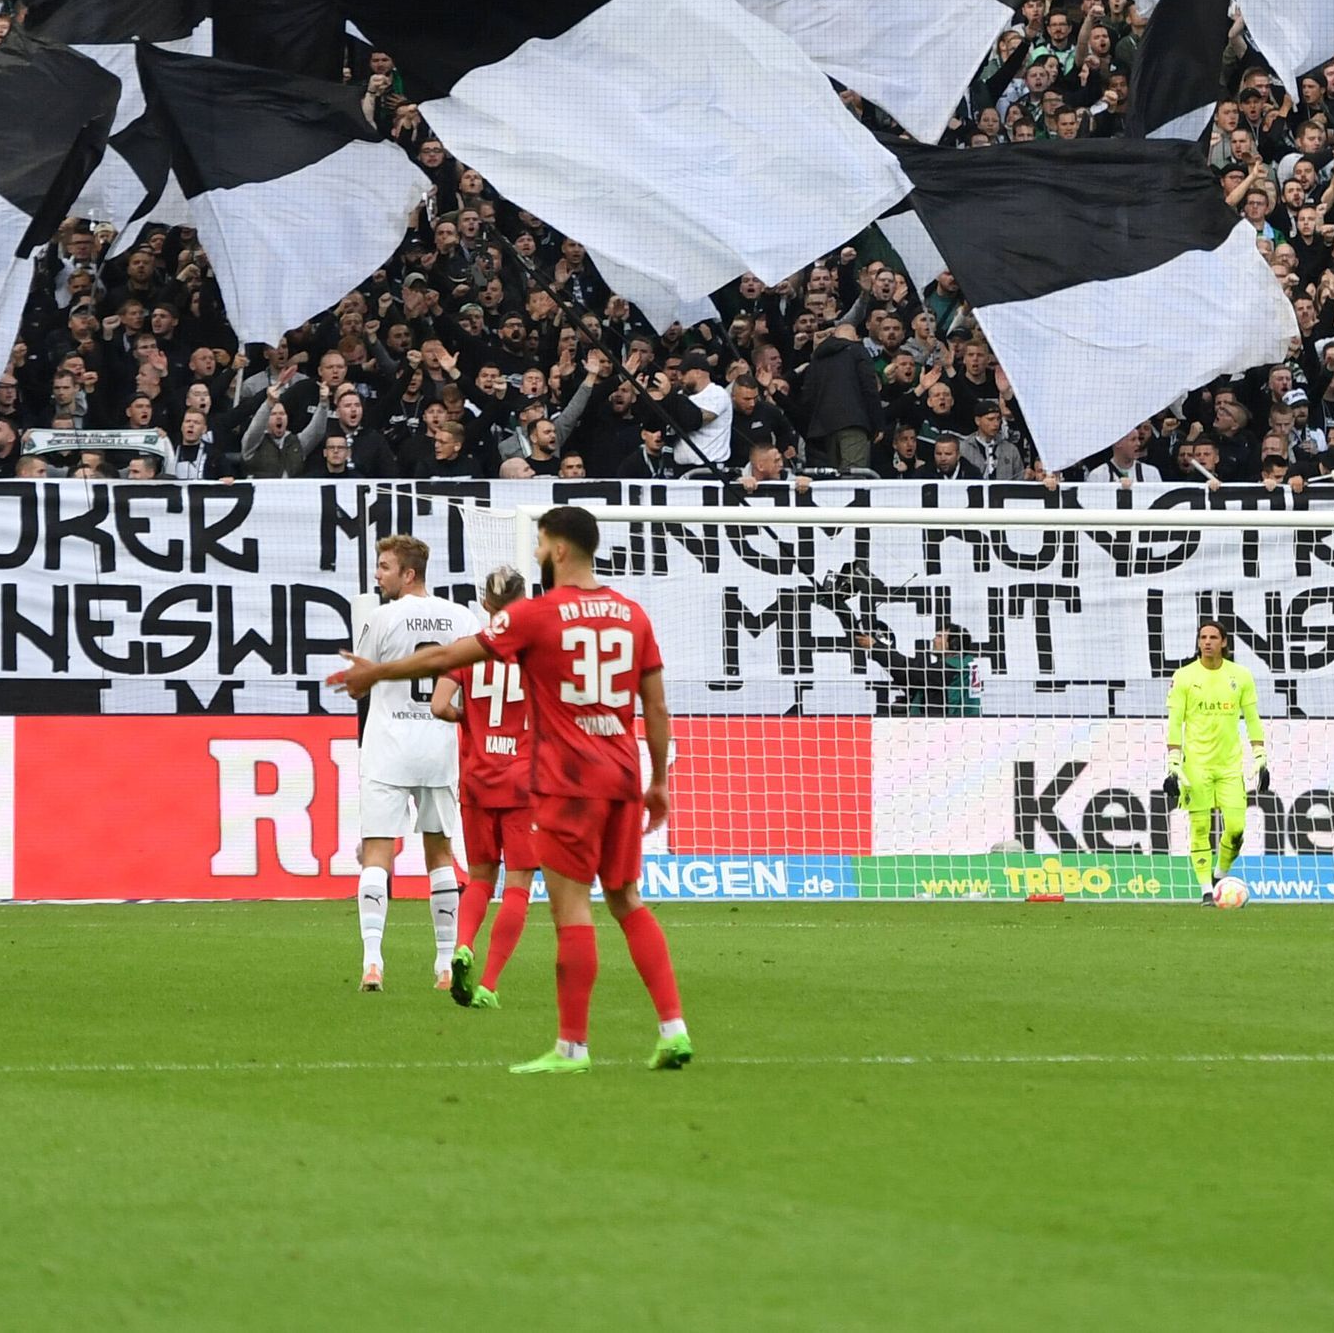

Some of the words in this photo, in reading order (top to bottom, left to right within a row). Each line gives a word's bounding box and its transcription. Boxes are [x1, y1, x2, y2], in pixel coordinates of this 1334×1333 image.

[320, 481, 491, 573] MIT
[406, 618, 453, 632] KRAMER
[559, 603, 579, 622] RB
[581, 601, 632, 622] LEIPZIG
[560, 625, 634, 708] 32
[485, 735, 518, 756] KAMPL
[589, 861, 787, 896] NGEN
